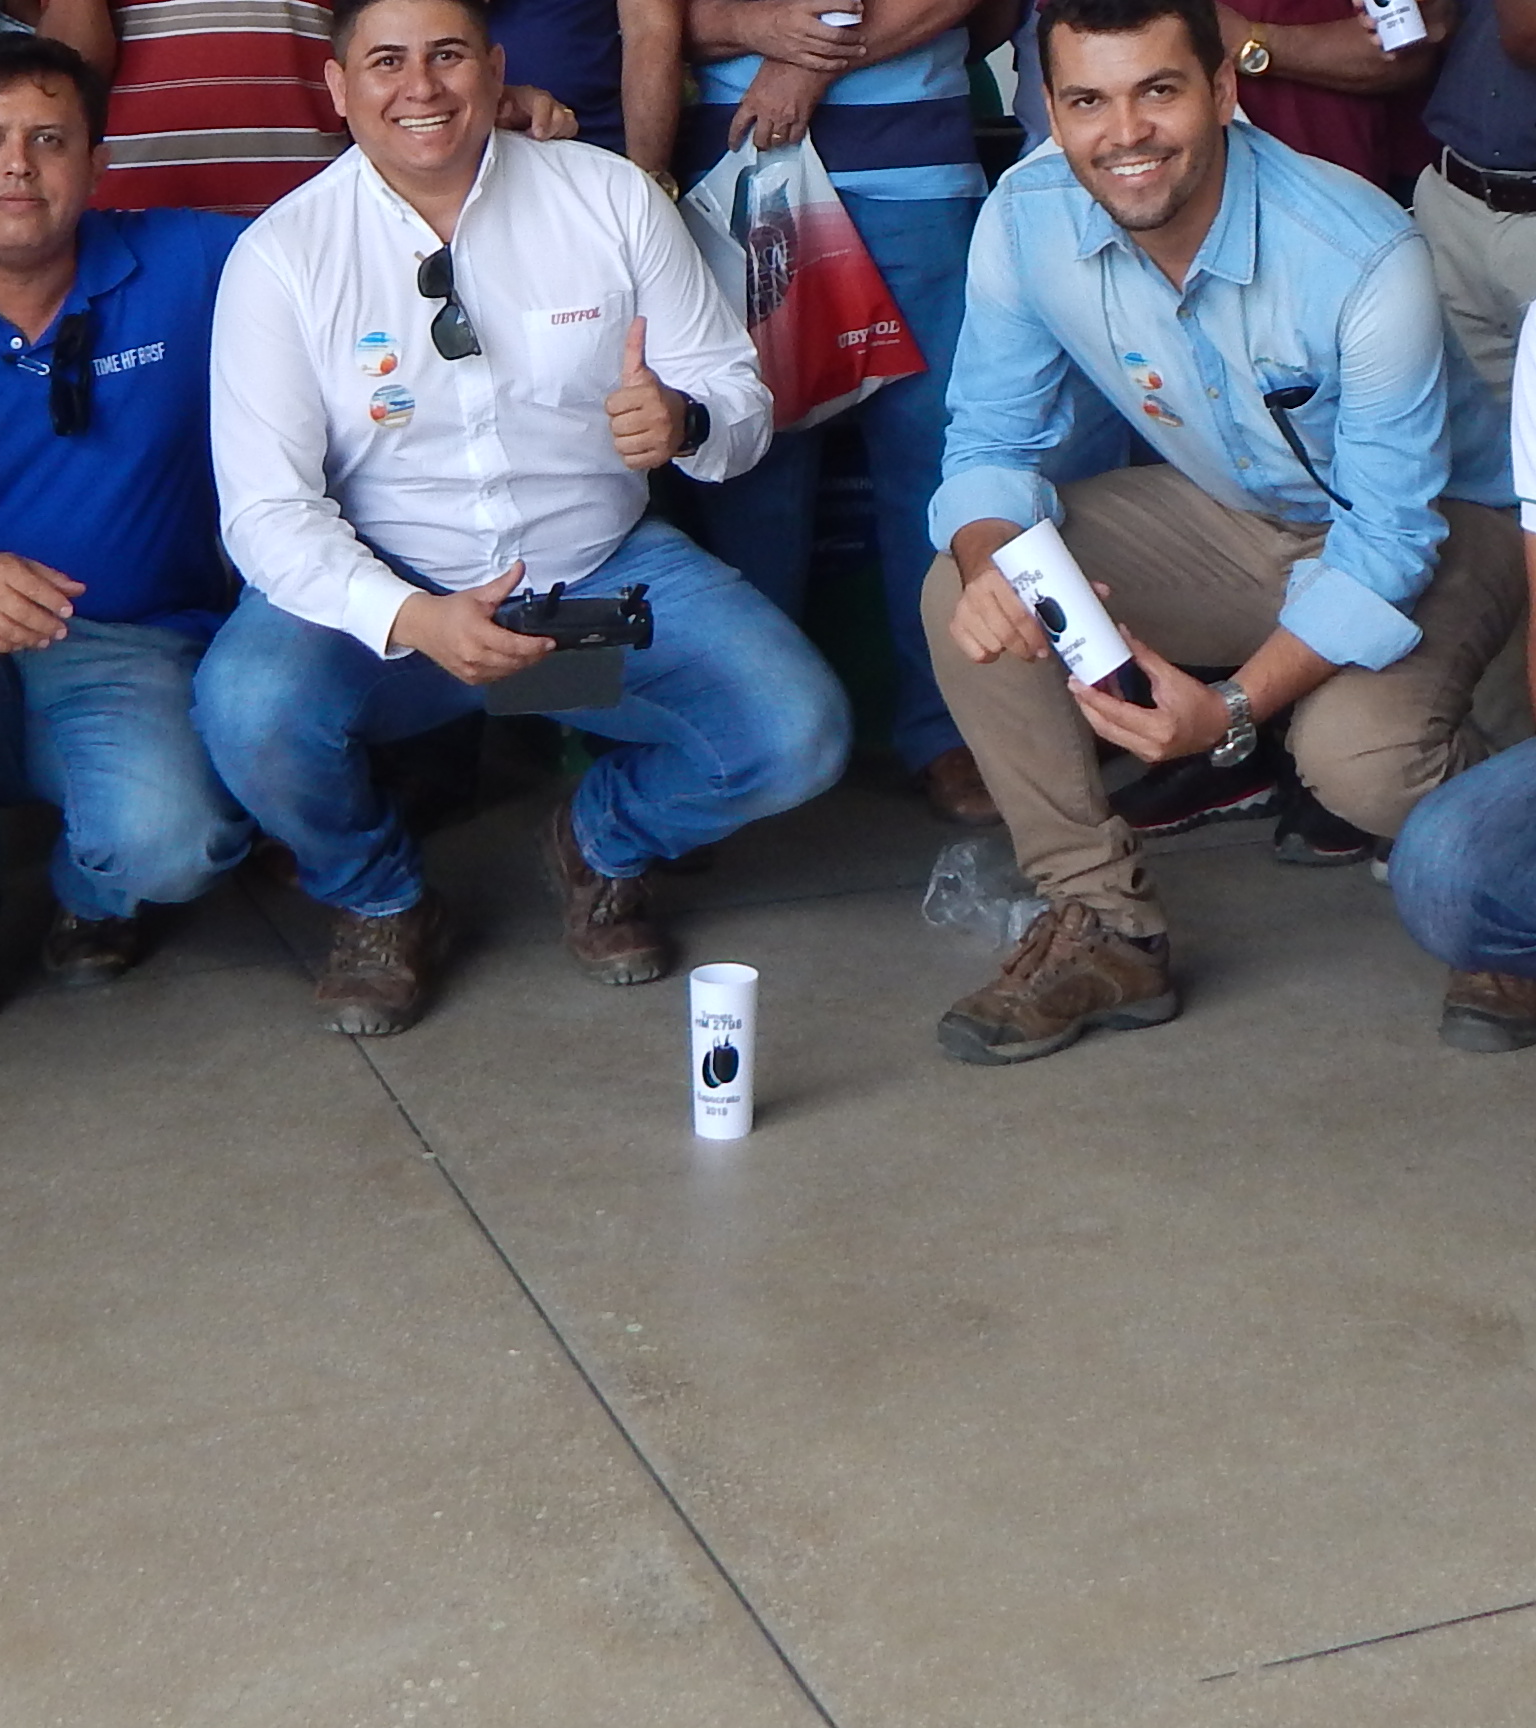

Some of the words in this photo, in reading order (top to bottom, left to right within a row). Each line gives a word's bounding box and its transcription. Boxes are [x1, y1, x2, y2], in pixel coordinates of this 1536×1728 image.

[551, 306, 602, 326] UBYFOL
[838, 319, 901, 349] UBYOL
[92, 353, 122, 377] TIME
[120, 348, 137, 370] HF
